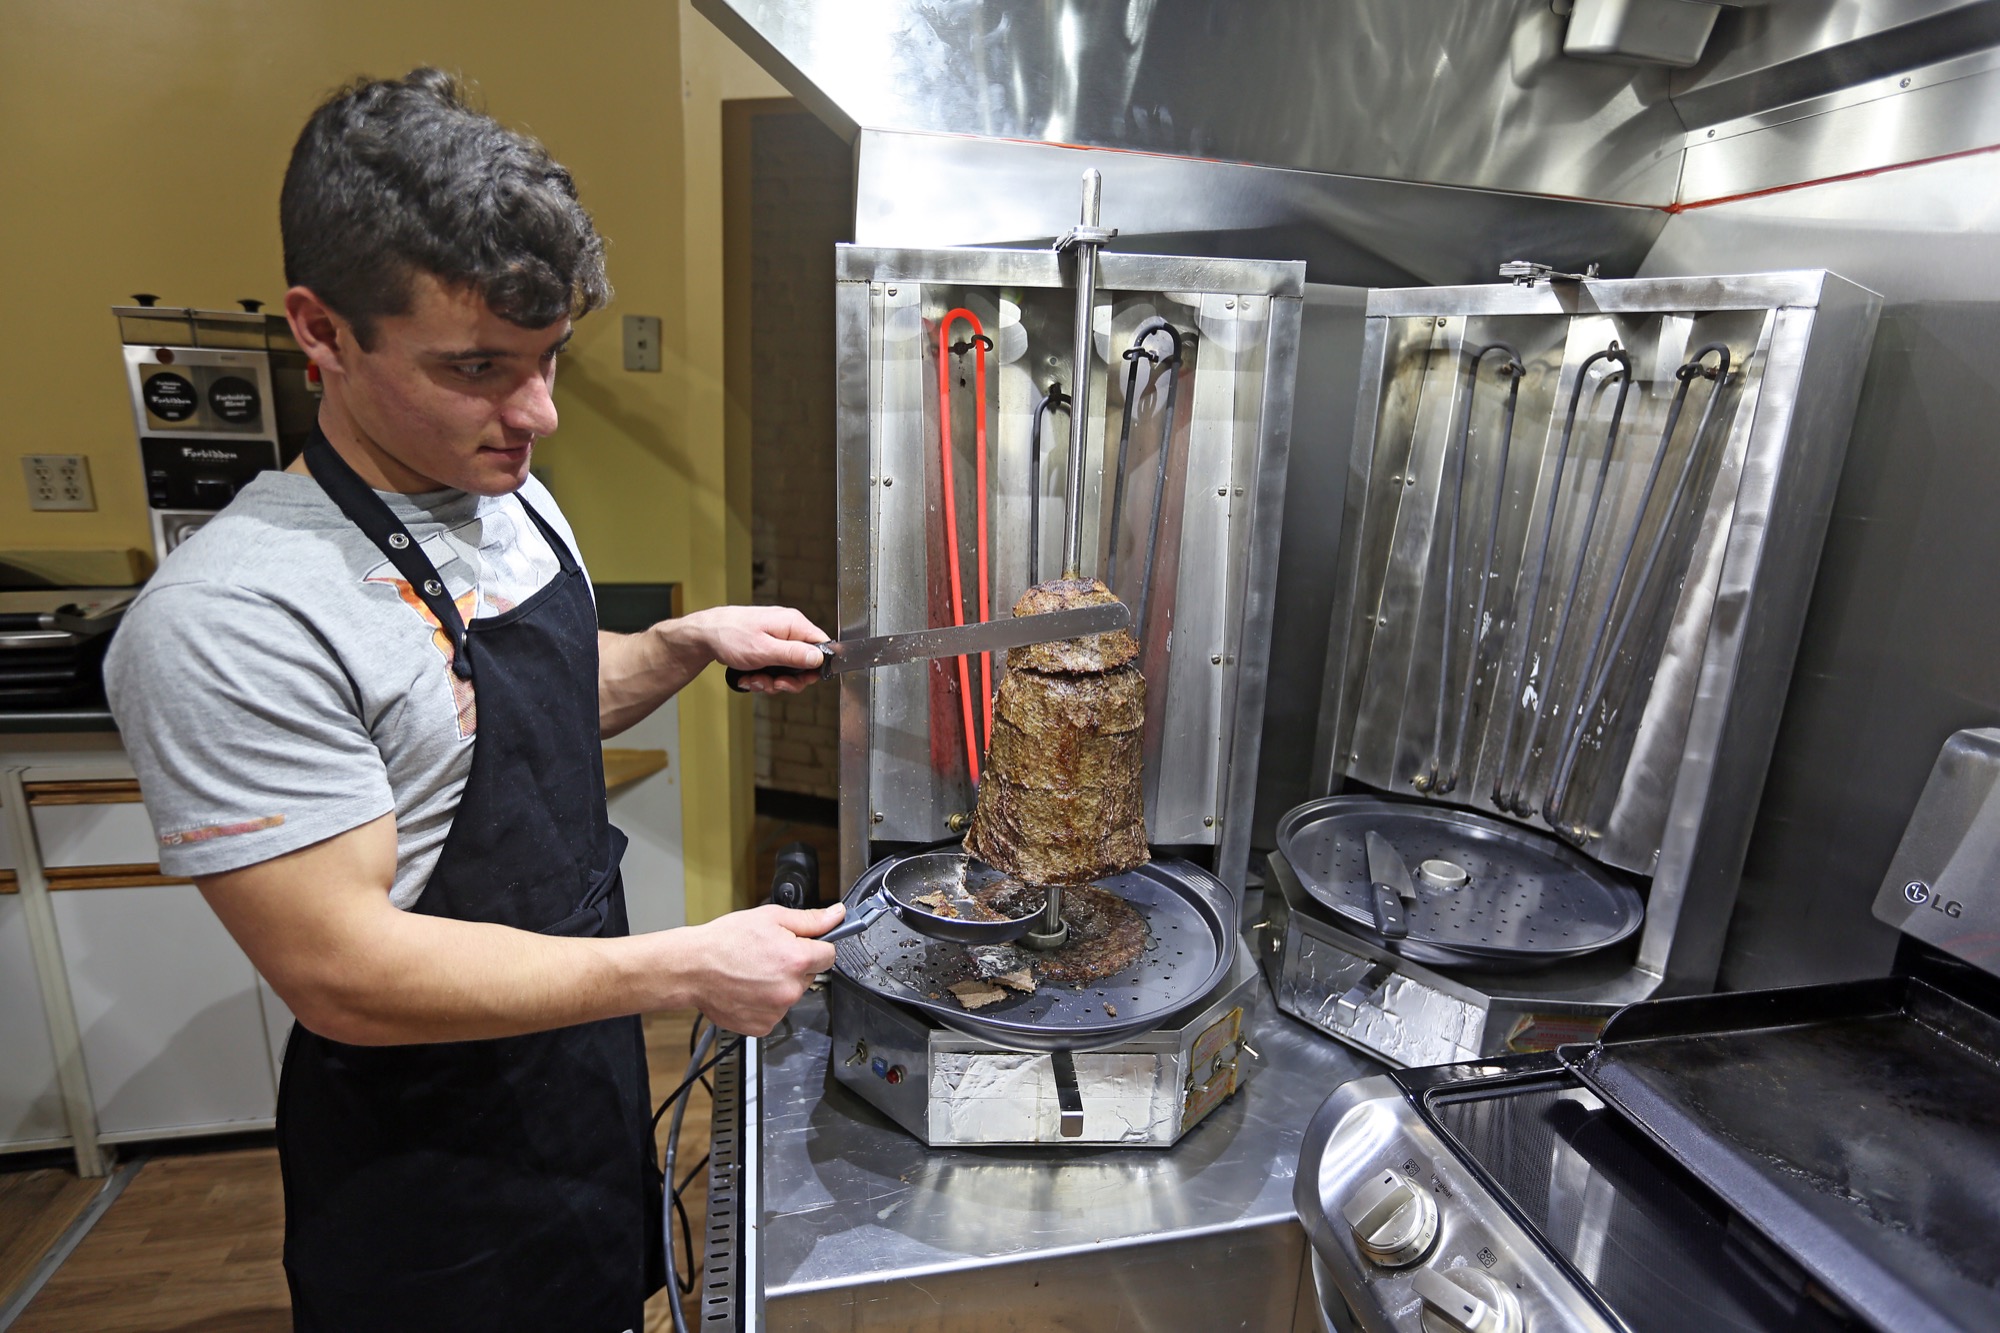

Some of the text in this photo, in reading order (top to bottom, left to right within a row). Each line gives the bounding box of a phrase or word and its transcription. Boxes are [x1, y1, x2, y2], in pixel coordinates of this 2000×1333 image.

[152, 396, 191, 404] Forbidden
[182, 447, 237, 458] Forbidden
[1930, 893, 1963, 919] LG
[1430, 1173, 1453, 1199] UltraHeat
